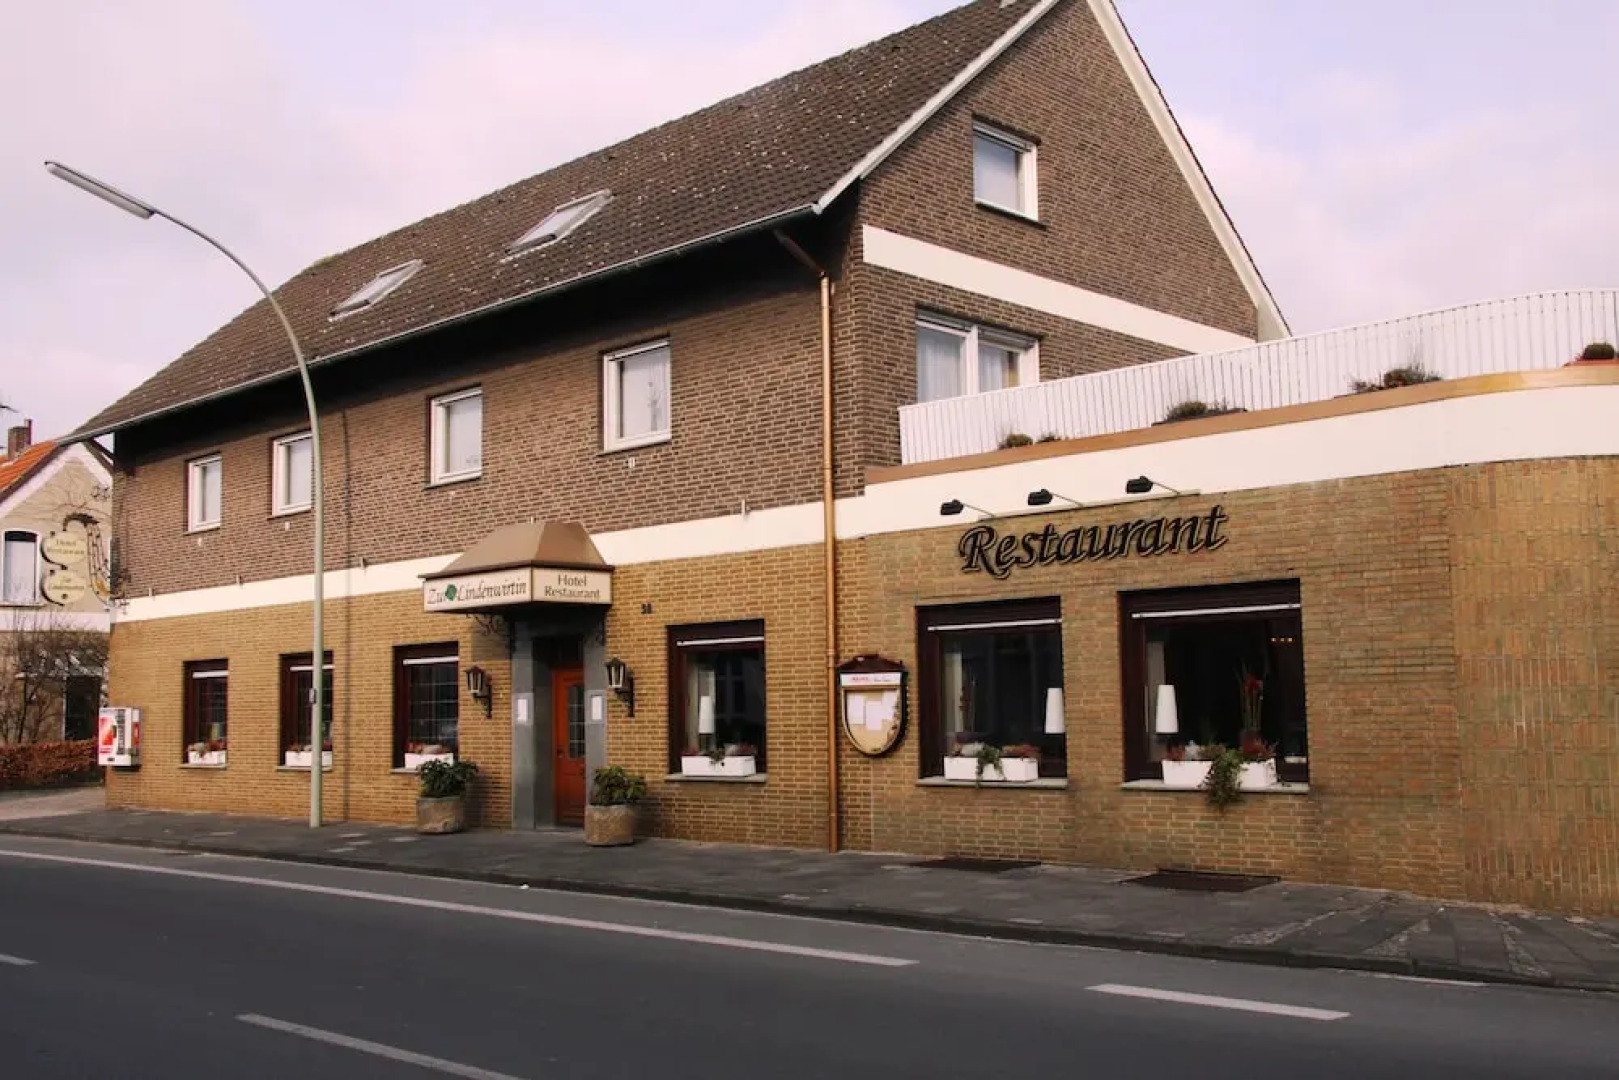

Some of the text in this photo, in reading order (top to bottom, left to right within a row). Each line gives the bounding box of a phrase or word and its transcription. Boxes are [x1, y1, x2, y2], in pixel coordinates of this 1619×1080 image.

[958, 504, 1229, 580] Restaurant
[457, 577, 527, 602] Lindenwirtin
[557, 574, 587, 587] Hotel
[544, 585, 600, 599] Restaurant
